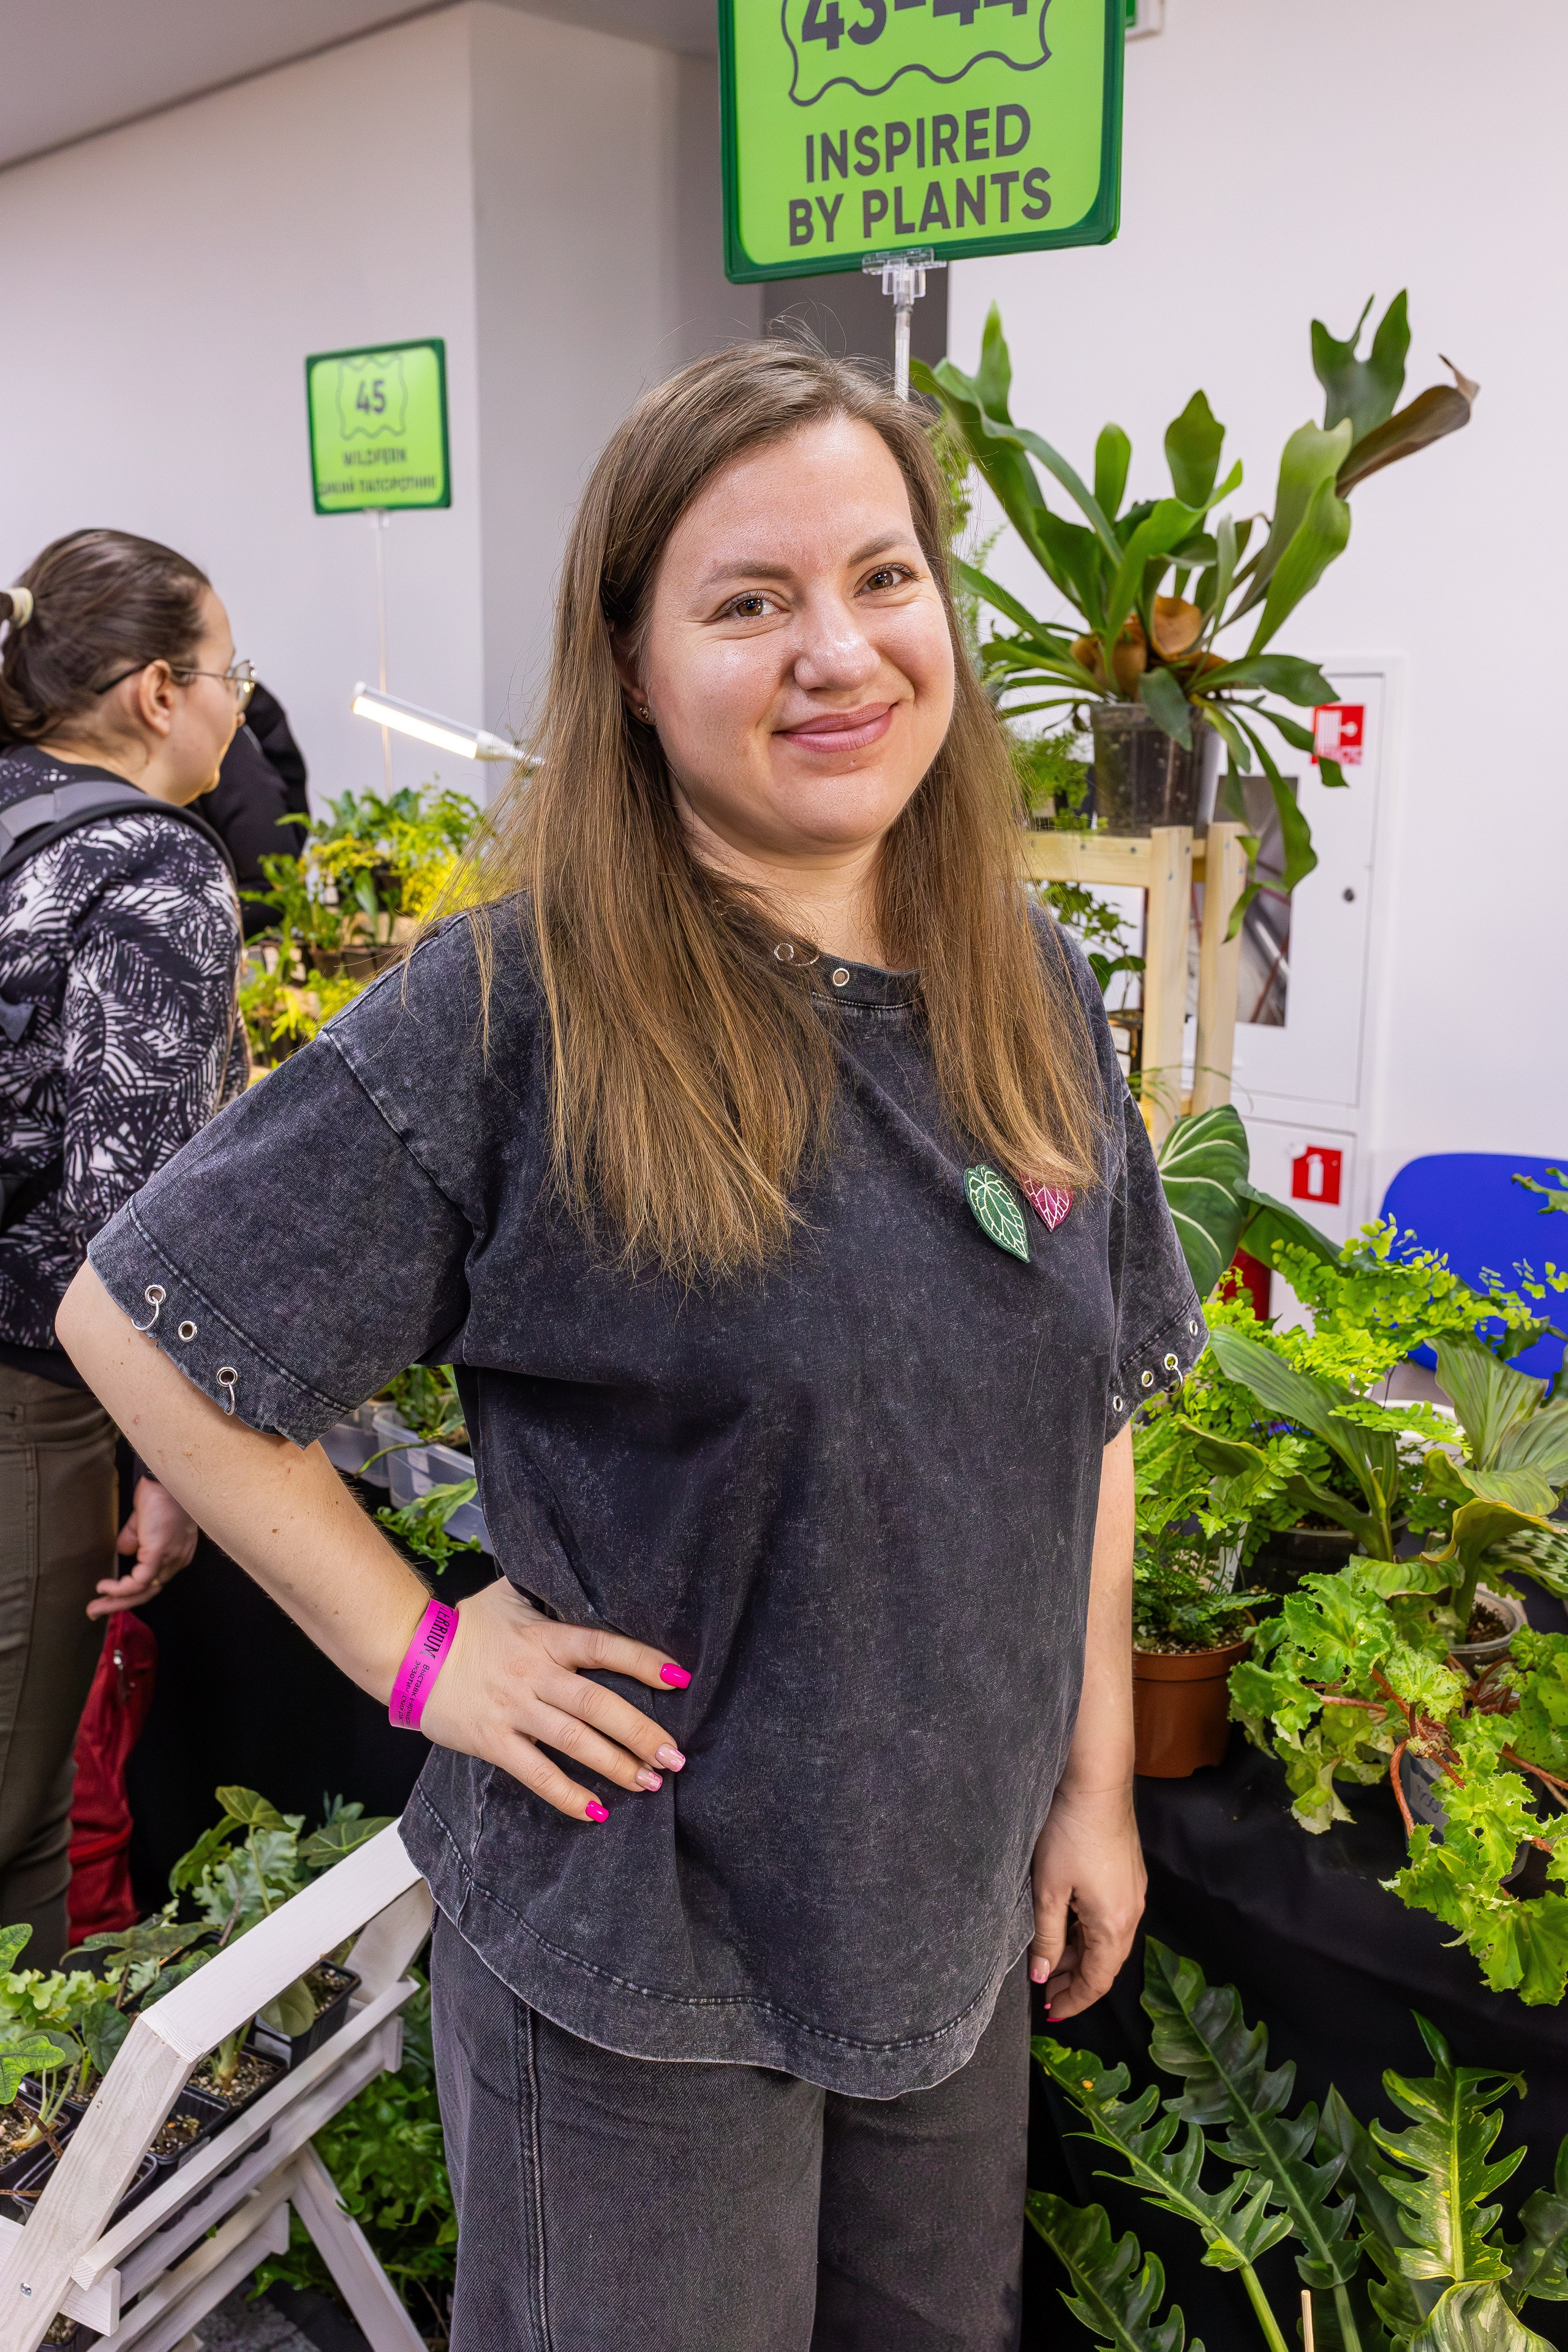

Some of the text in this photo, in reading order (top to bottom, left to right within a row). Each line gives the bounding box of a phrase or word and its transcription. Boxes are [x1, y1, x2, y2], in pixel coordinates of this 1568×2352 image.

[801, 0, 1028, 51] 43-
[805, 104, 1031, 183] INSPIRED
[788, 167, 1052, 246] BY PLANTS
[355, 378, 387, 416] 45
